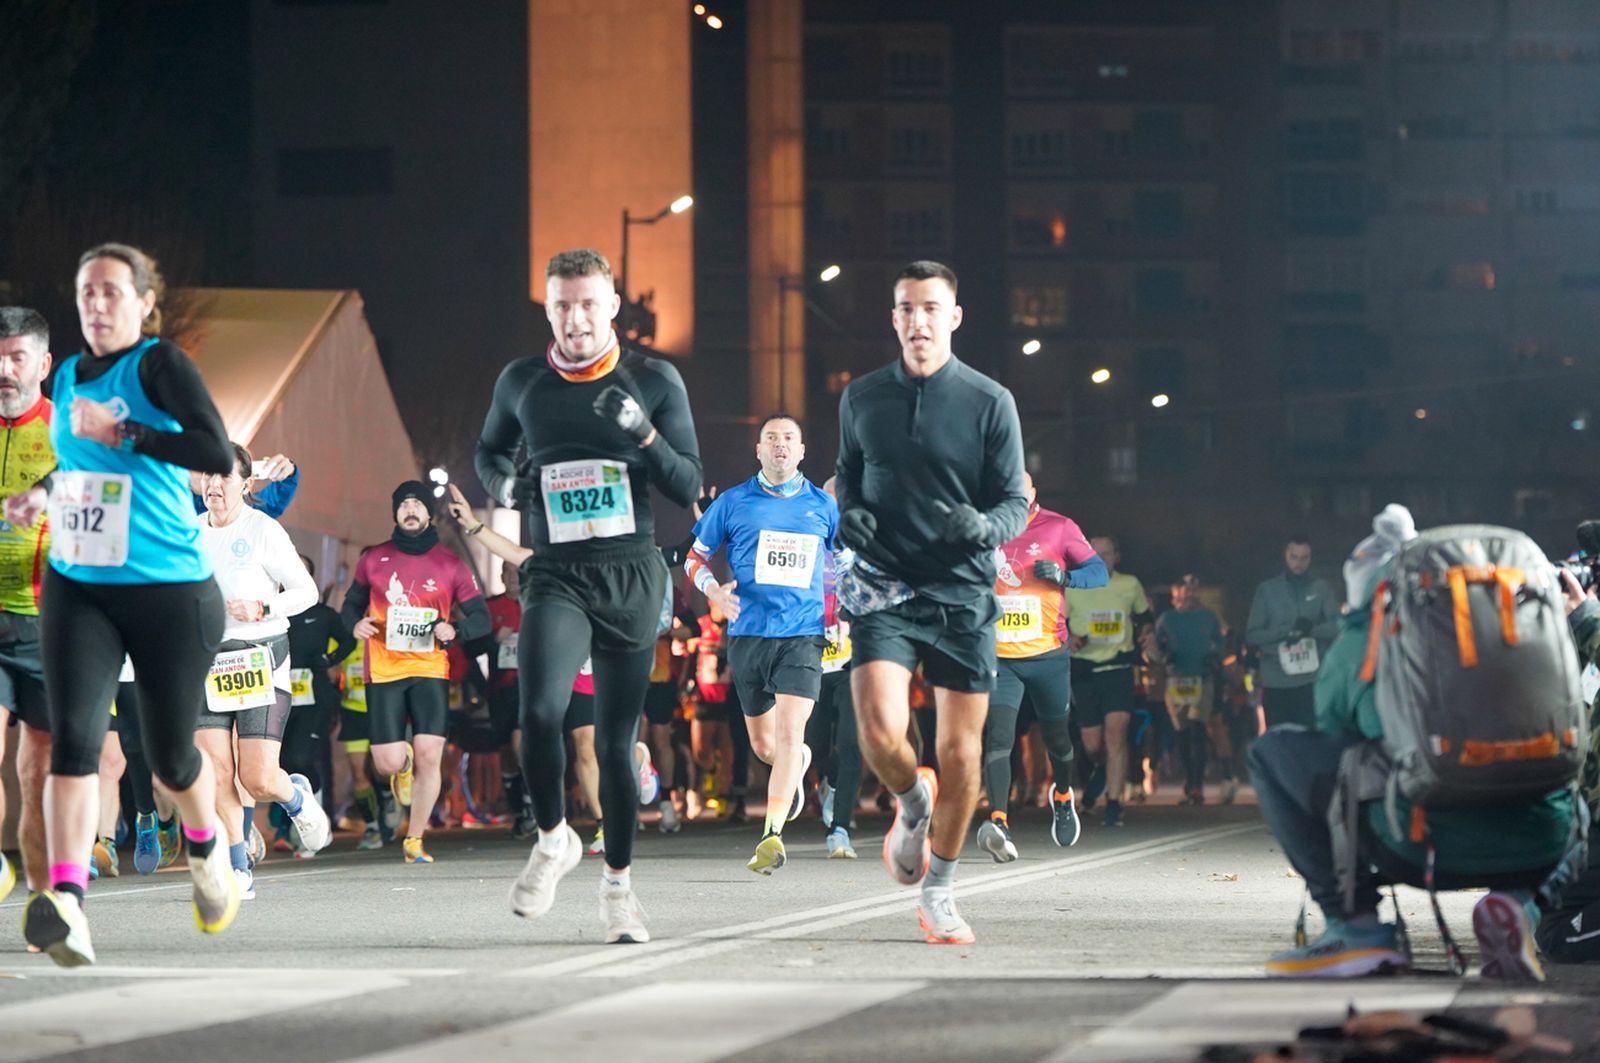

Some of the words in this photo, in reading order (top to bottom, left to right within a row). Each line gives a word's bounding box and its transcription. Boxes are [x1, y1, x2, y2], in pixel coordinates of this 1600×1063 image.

[586, 468, 595, 477] DE
[551, 482, 567, 490] SAN
[560, 486, 615, 514] 8324
[767, 550, 807, 569] 6598
[216, 658, 236, 666] NOCHE
[210, 667, 224, 675] SAN
[213, 668, 264, 692] 13901
